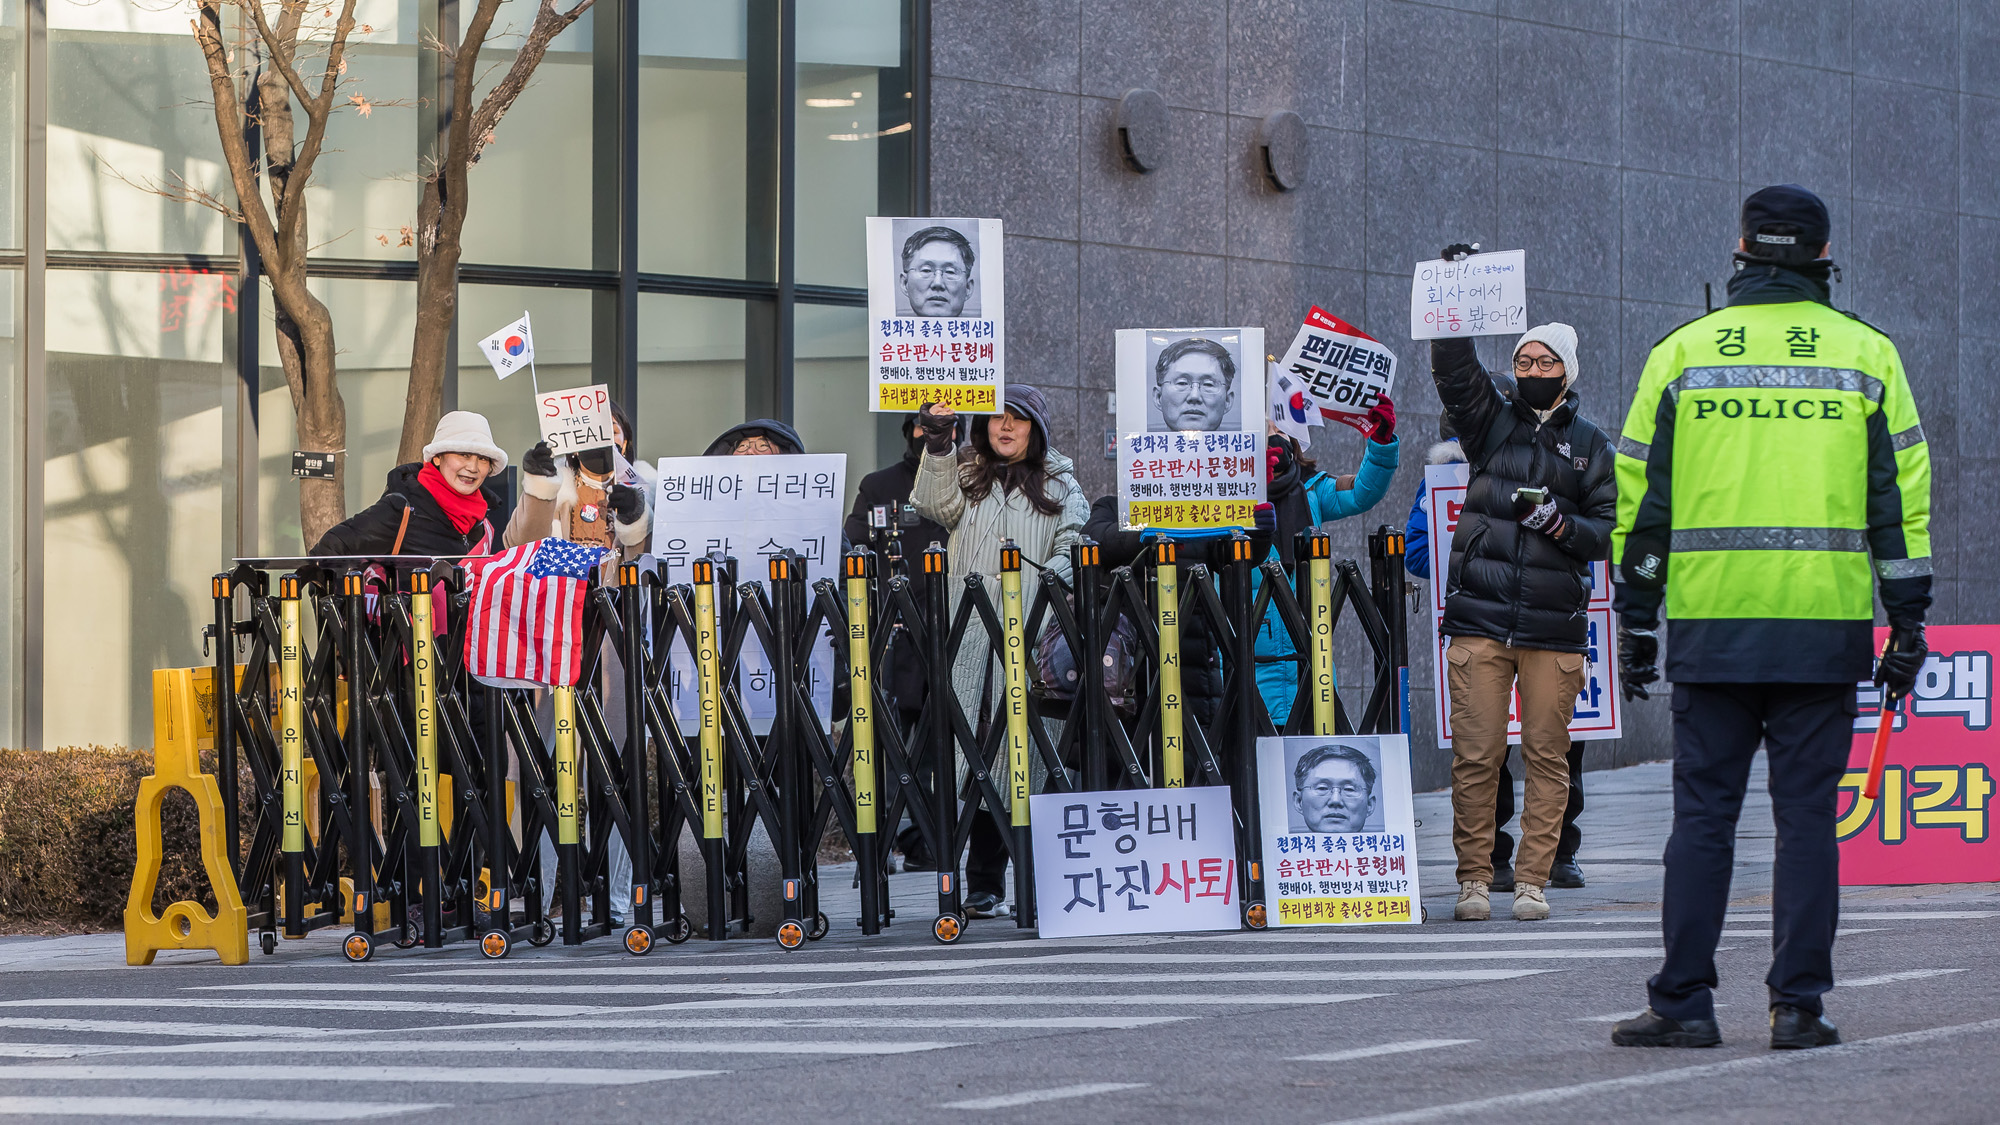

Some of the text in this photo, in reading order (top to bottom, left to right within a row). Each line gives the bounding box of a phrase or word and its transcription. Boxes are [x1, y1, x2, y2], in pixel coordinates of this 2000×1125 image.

[1759, 234, 1792, 243] POLICE
[1421, 262, 1469, 283] 아빠!
[920, 320, 943, 338] 졸속
[947, 320, 994, 338] 탄핵심리
[1424, 305, 1523, 331] 야동 봤어?!
[1299, 334, 1392, 383] 편파탄핵
[880, 366, 913, 380] 행배야,
[915, 367, 955, 380] 행번방서
[543, 390, 607, 418] STOP
[881, 387, 995, 407] 우리법회장 출신은 다르네
[1694, 399, 1843, 419] POLICE
[562, 415, 590, 426] THE
[547, 425, 611, 448] STEAL
[1204, 433, 1256, 453] 탄핵심리
[663, 472, 836, 502] 행배야 더러워
[1130, 482, 1166, 498] 행배야,
[1169, 482, 1213, 497] 행번방서
[1130, 504, 1185, 523] 우리법회장
[1189, 504, 1222, 523] 출신은
[1317, 605, 1330, 702] POLICE
[850, 624, 872, 807] 질서유지선
[1008, 617, 1025, 799] POLICE LINE
[416, 640, 432, 821] POLICE LINE
[700, 630, 716, 812] POLICE LINE
[282, 645, 299, 826] 질서유지선
[1057, 800, 1197, 859] 문형배
[1321, 836, 1347, 853] 졸속
[1352, 834, 1405, 853] 탄핵심리
[1063, 858, 1234, 913] 자진사퇴
[1278, 881, 1316, 896] 행배야,
[1319, 880, 1363, 894] 행번방서
[1280, 899, 1411, 919] 우리법회장 출신은 다르네
